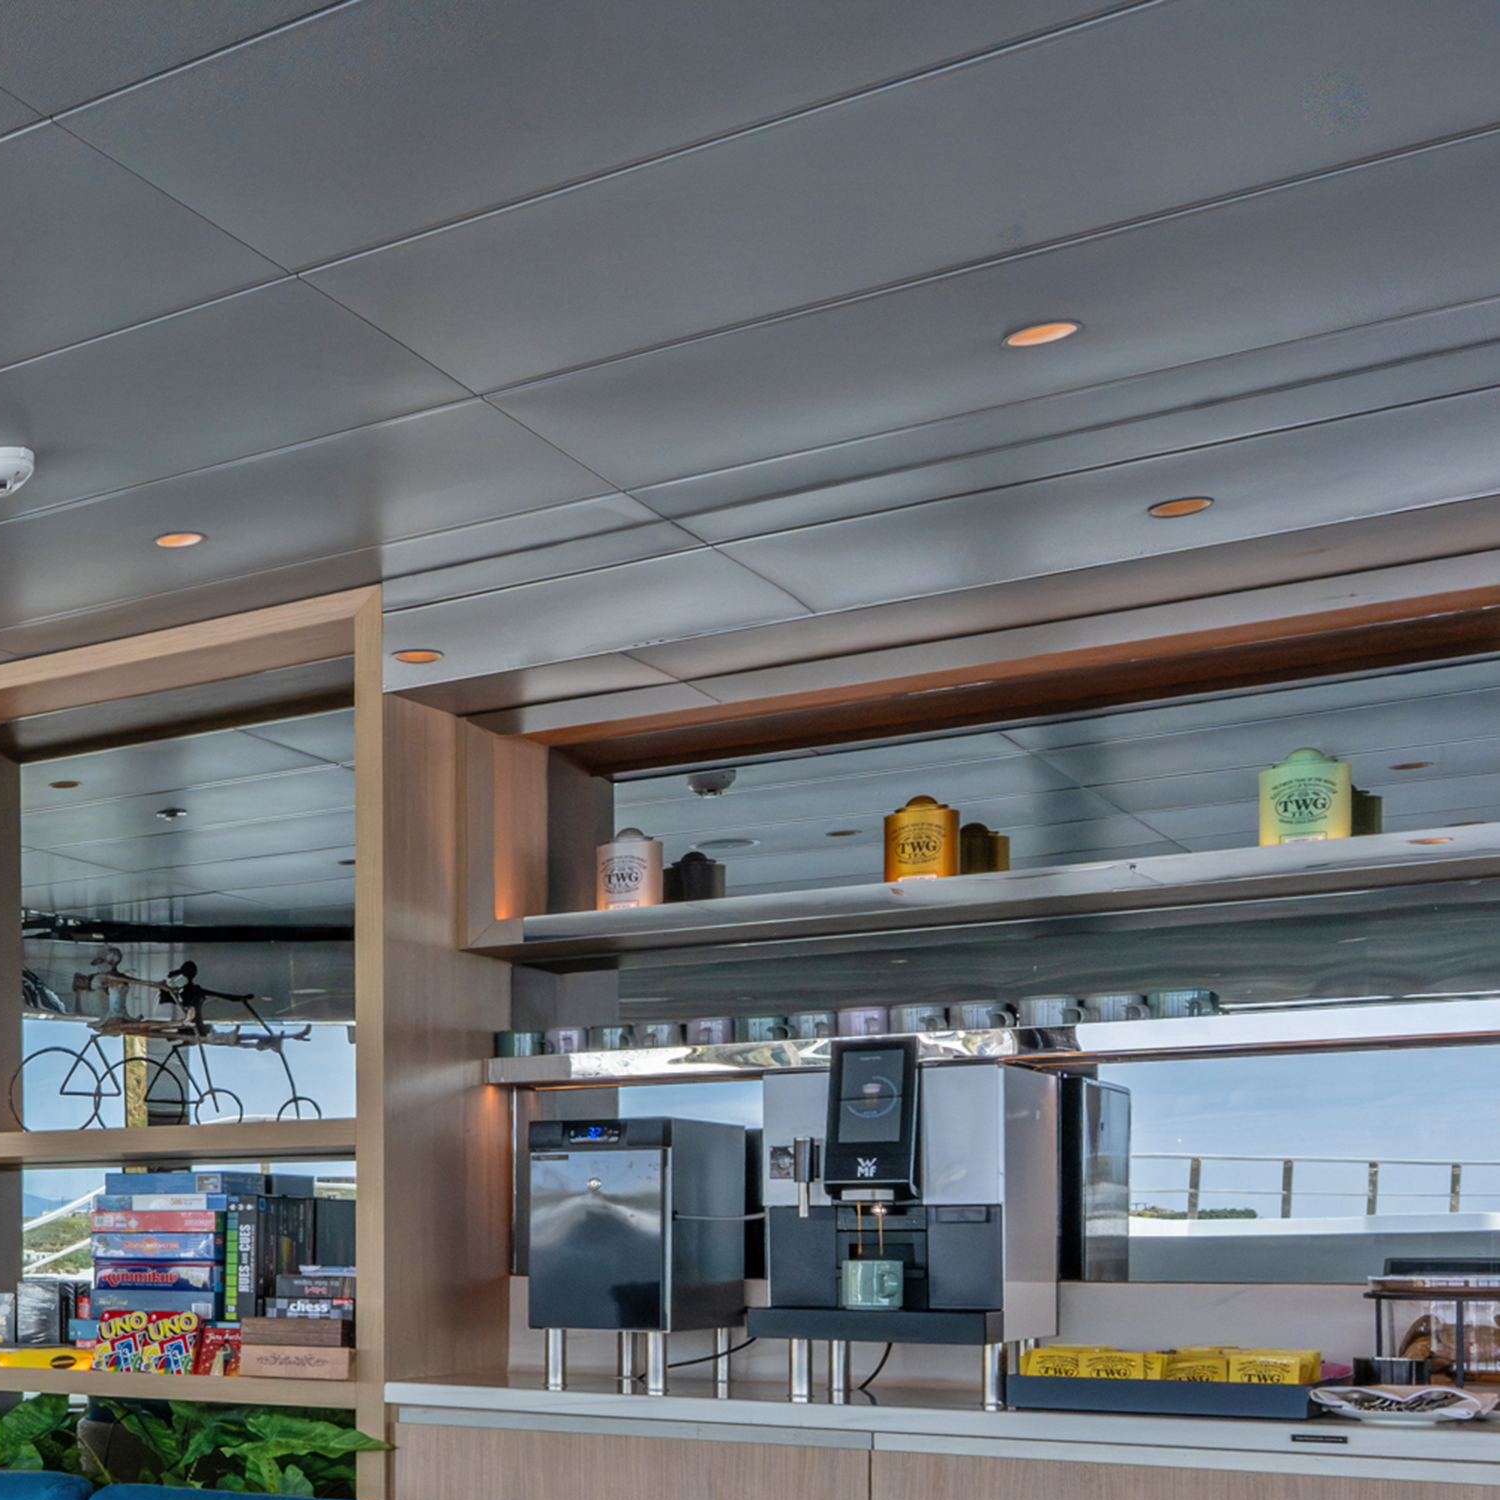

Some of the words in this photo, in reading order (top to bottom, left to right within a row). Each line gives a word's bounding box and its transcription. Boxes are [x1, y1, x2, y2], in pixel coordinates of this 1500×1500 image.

[1279, 797, 1327, 813] TWG
[1290, 810, 1314, 818] TEA
[898, 840, 937, 854] TWG
[605, 872, 639, 884] TWG
[857, 1157, 877, 1178] WMF
[239, 1224, 251, 1252] CUES
[102, 1270, 178, 1288] Rummikub
[238, 1265, 250, 1293] HUES
[289, 1300, 328, 1313] chess
[100, 1311, 147, 1340] UNO
[148, 1311, 198, 1341] UNO
[1041, 1366, 1077, 1377] TWG
[1092, 1368, 1127, 1379] TWG
[1243, 1374, 1281, 1384] TWG
